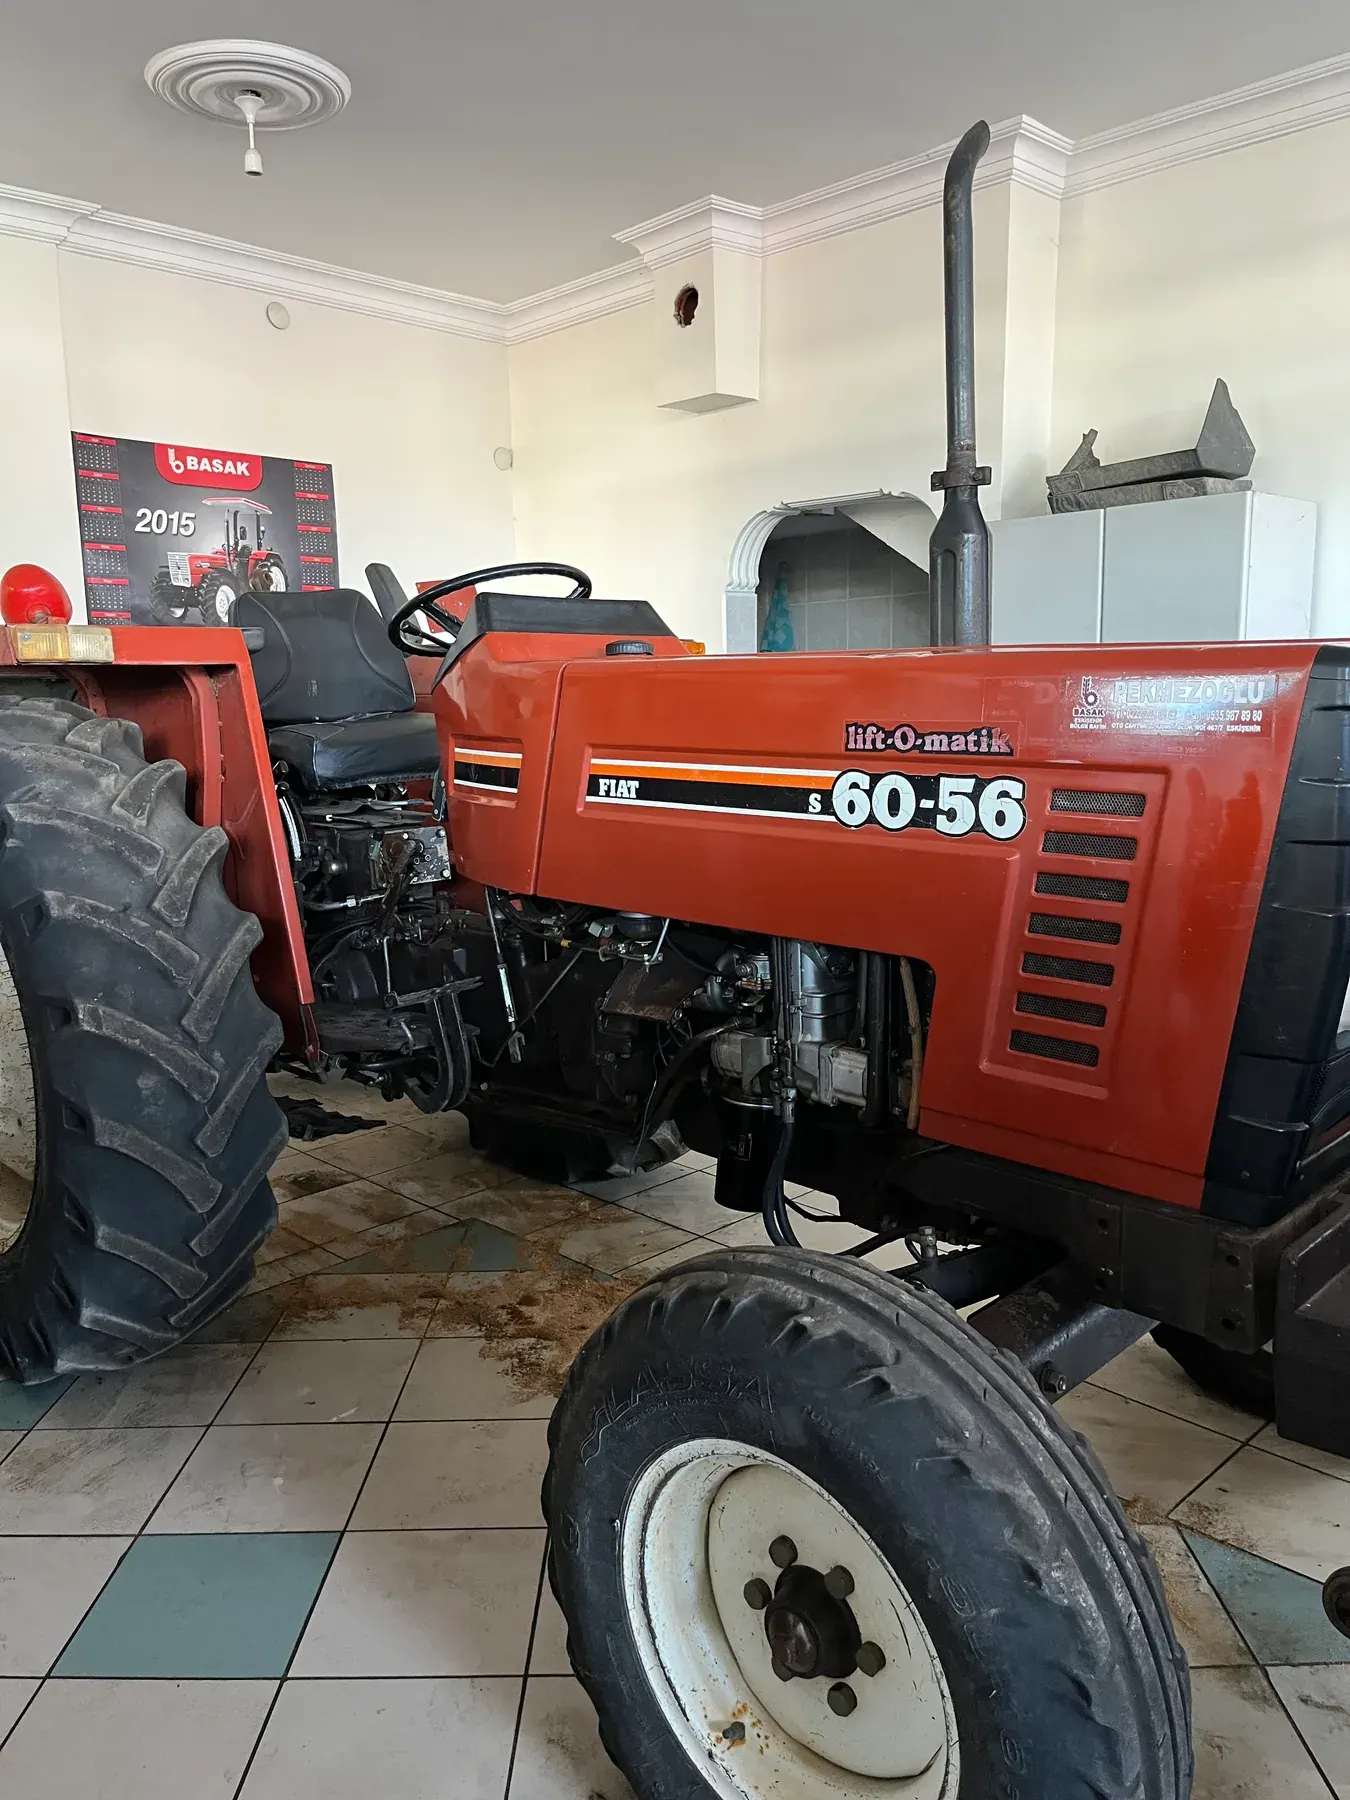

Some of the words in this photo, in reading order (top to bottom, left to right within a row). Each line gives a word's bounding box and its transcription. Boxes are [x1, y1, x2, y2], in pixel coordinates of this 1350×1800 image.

[134, 508, 197, 537] 2015
[847, 725, 1012, 753] lift-O-matik
[598, 778, 639, 799] FIAT
[831, 769, 1027, 840] 60-56
